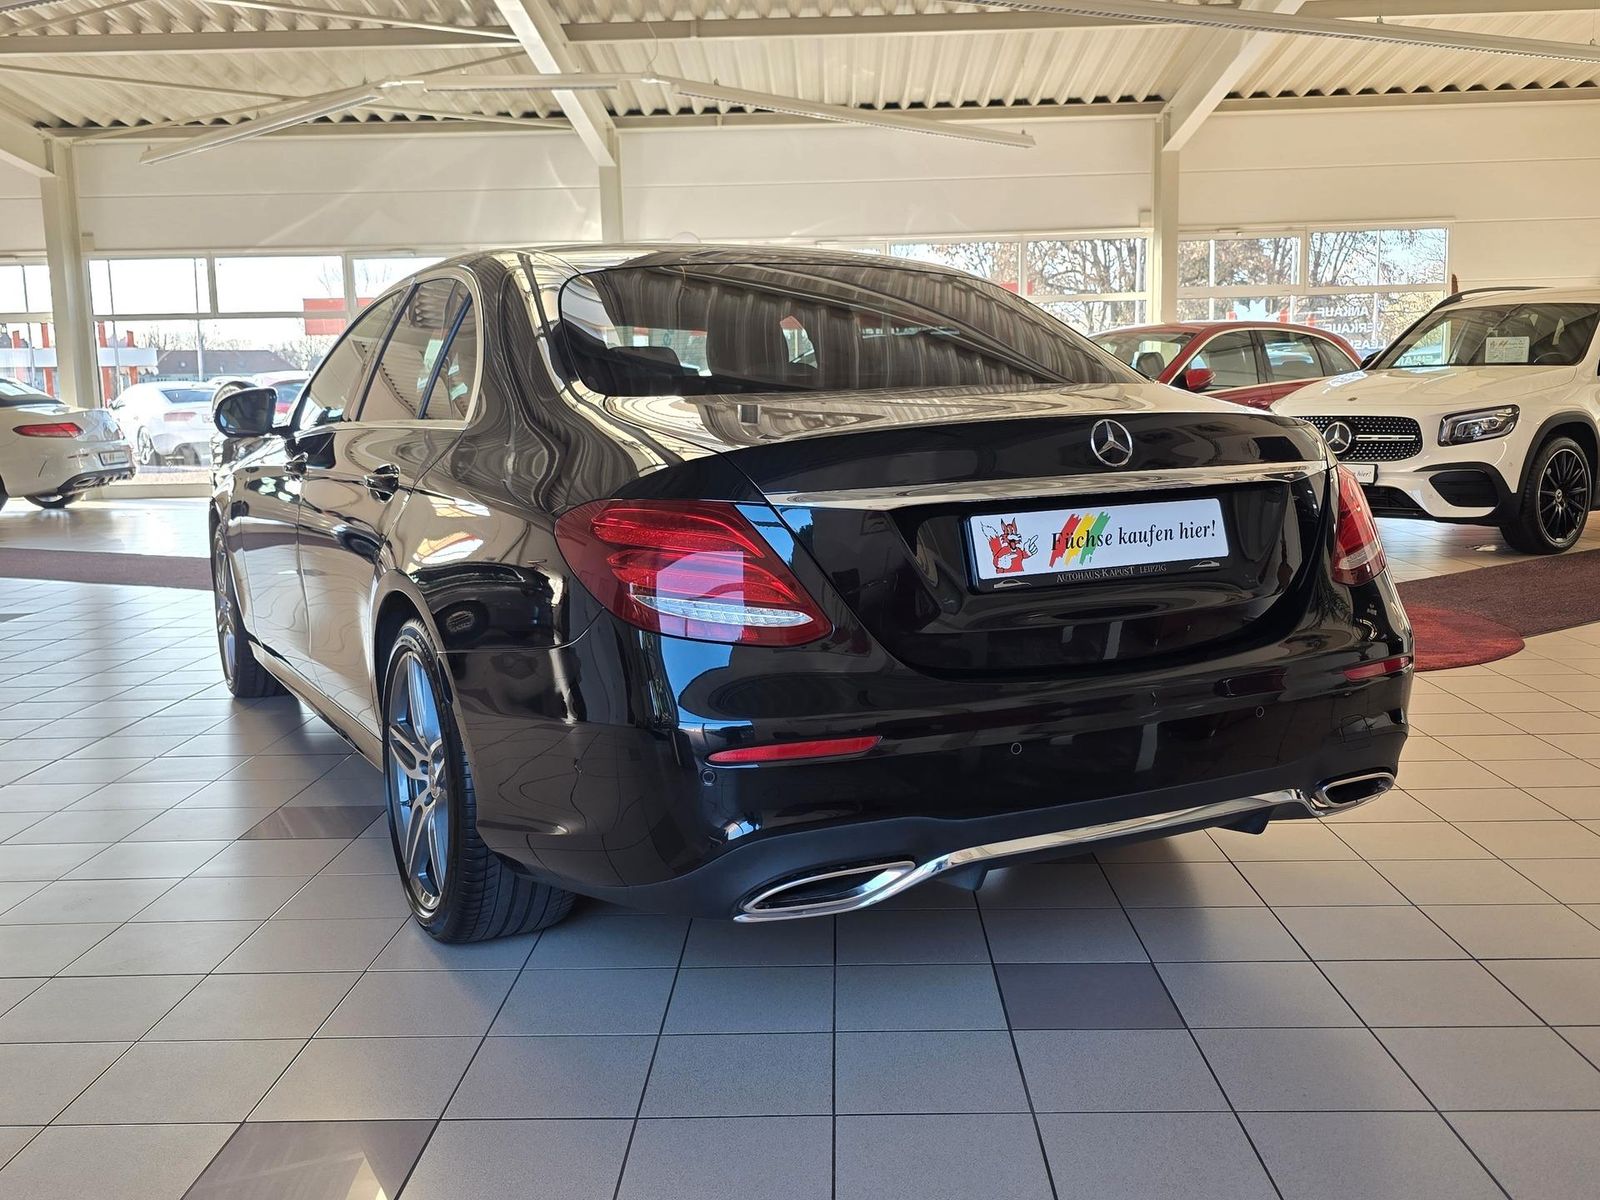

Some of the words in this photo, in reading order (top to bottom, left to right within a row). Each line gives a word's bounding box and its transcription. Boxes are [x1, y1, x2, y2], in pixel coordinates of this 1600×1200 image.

[1051, 529, 1113, 551] Füchse
[1118, 523, 1174, 547] kaufen
[1179, 519, 1216, 540] hier!
[1139, 563, 1167, 574] LEIPZIG
